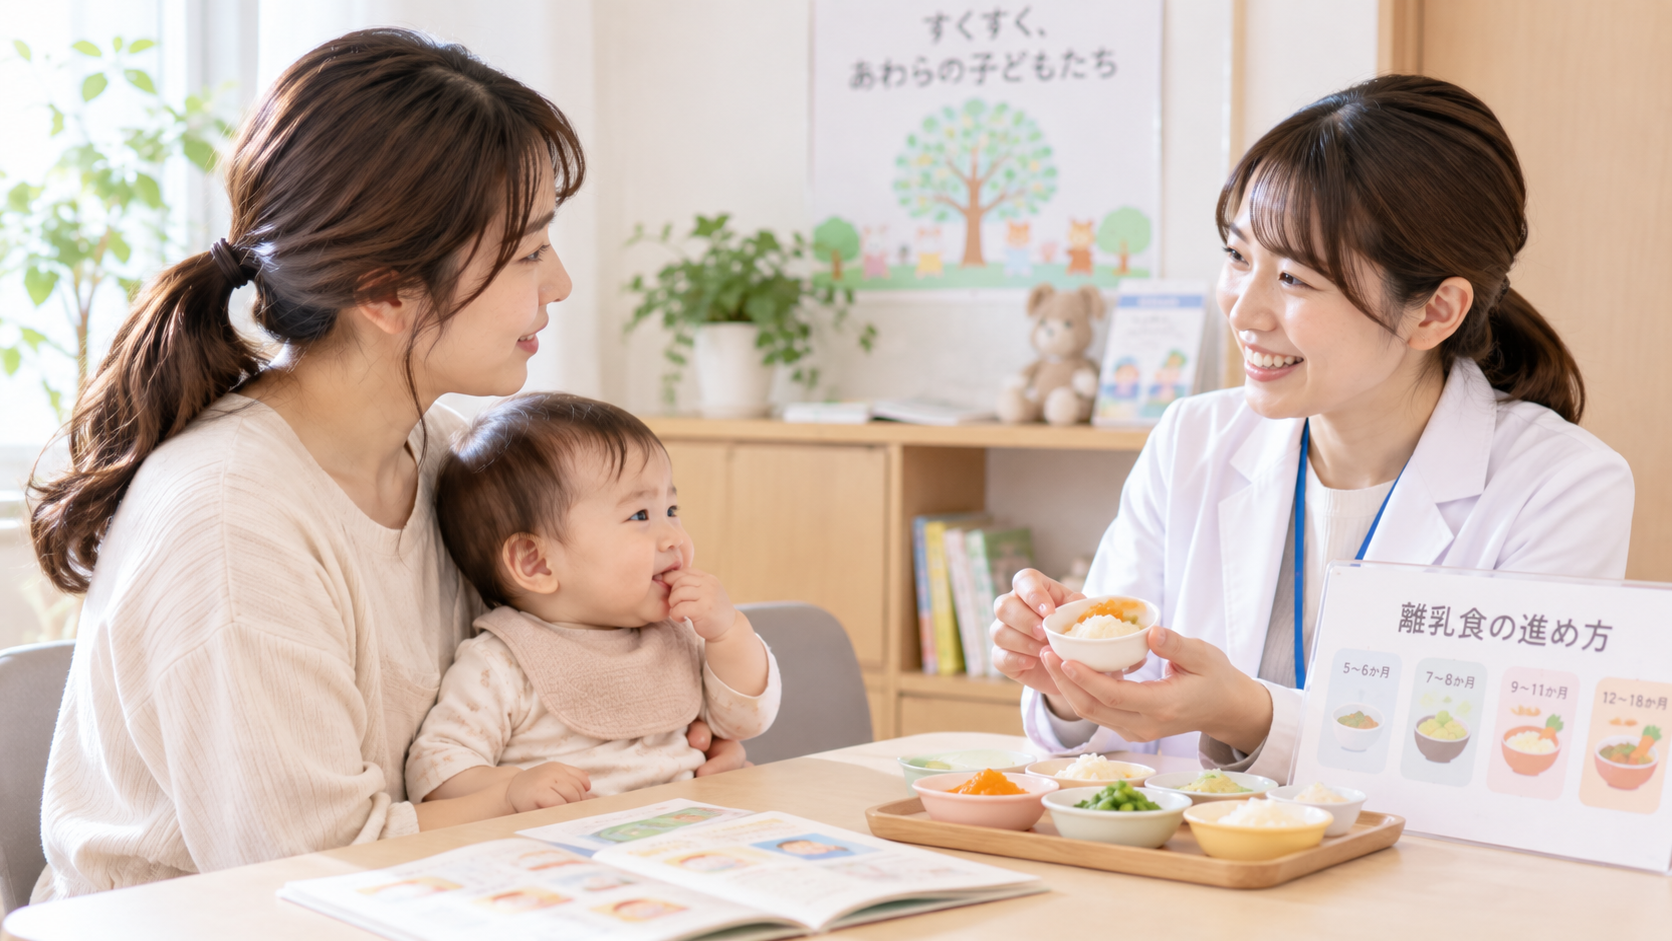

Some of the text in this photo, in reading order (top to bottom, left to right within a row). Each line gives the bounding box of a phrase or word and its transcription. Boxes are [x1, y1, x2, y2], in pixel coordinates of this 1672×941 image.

[922, 6, 1046, 45] すくすく、
[849, 46, 1118, 90] あわらの子どもたち
[1398, 602, 1613, 652] 離乳食の進め方
